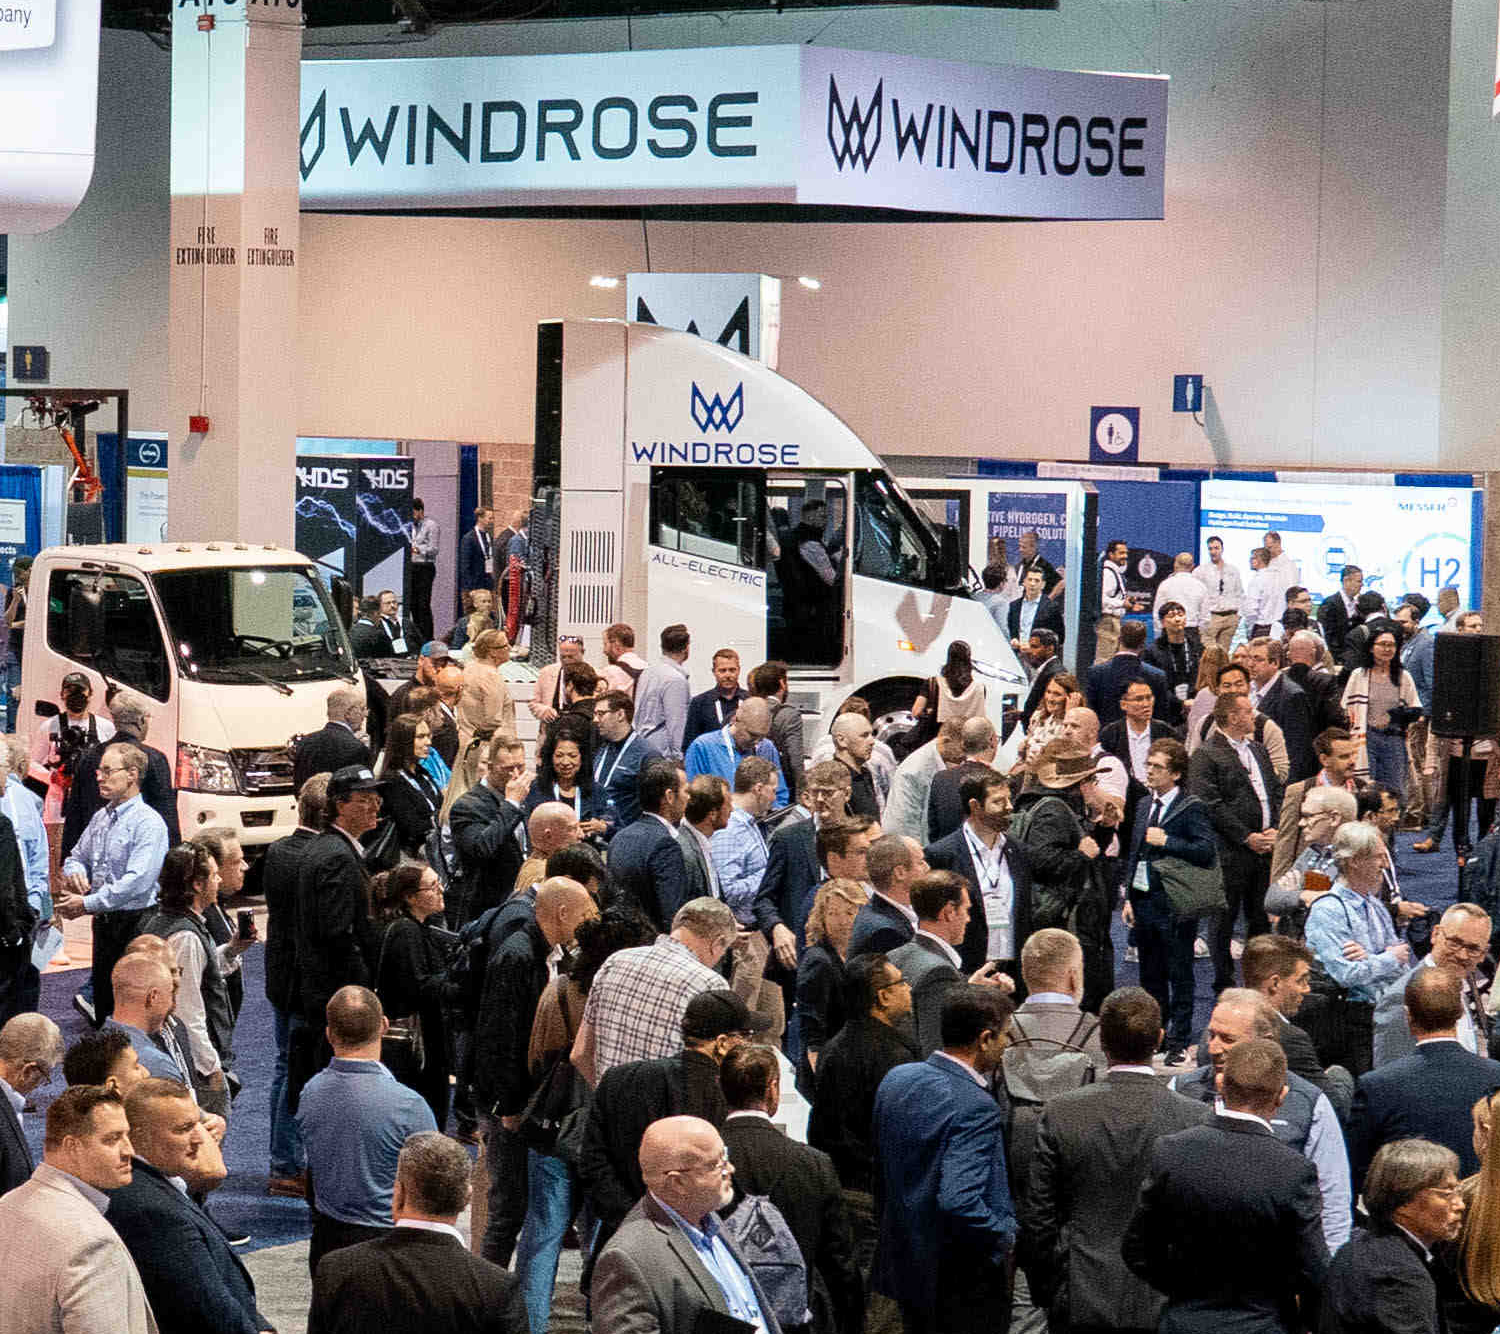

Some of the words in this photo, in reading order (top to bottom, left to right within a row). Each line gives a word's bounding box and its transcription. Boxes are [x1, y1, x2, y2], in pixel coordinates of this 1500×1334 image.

[340, 91, 760, 167] WINDROSE
[891, 97, 1148, 179] WINDROSE
[197, 227, 216, 244] FIRE
[263, 227, 279, 245] FIRE
[176, 247, 236, 266] EXTINGUISHER
[631, 442, 801, 466] WINDROSE
[1398, 501, 1446, 512] MESSER
[652, 553, 764, 588] ALL-ELECTRIC
[1420, 556, 1461, 589] H2
